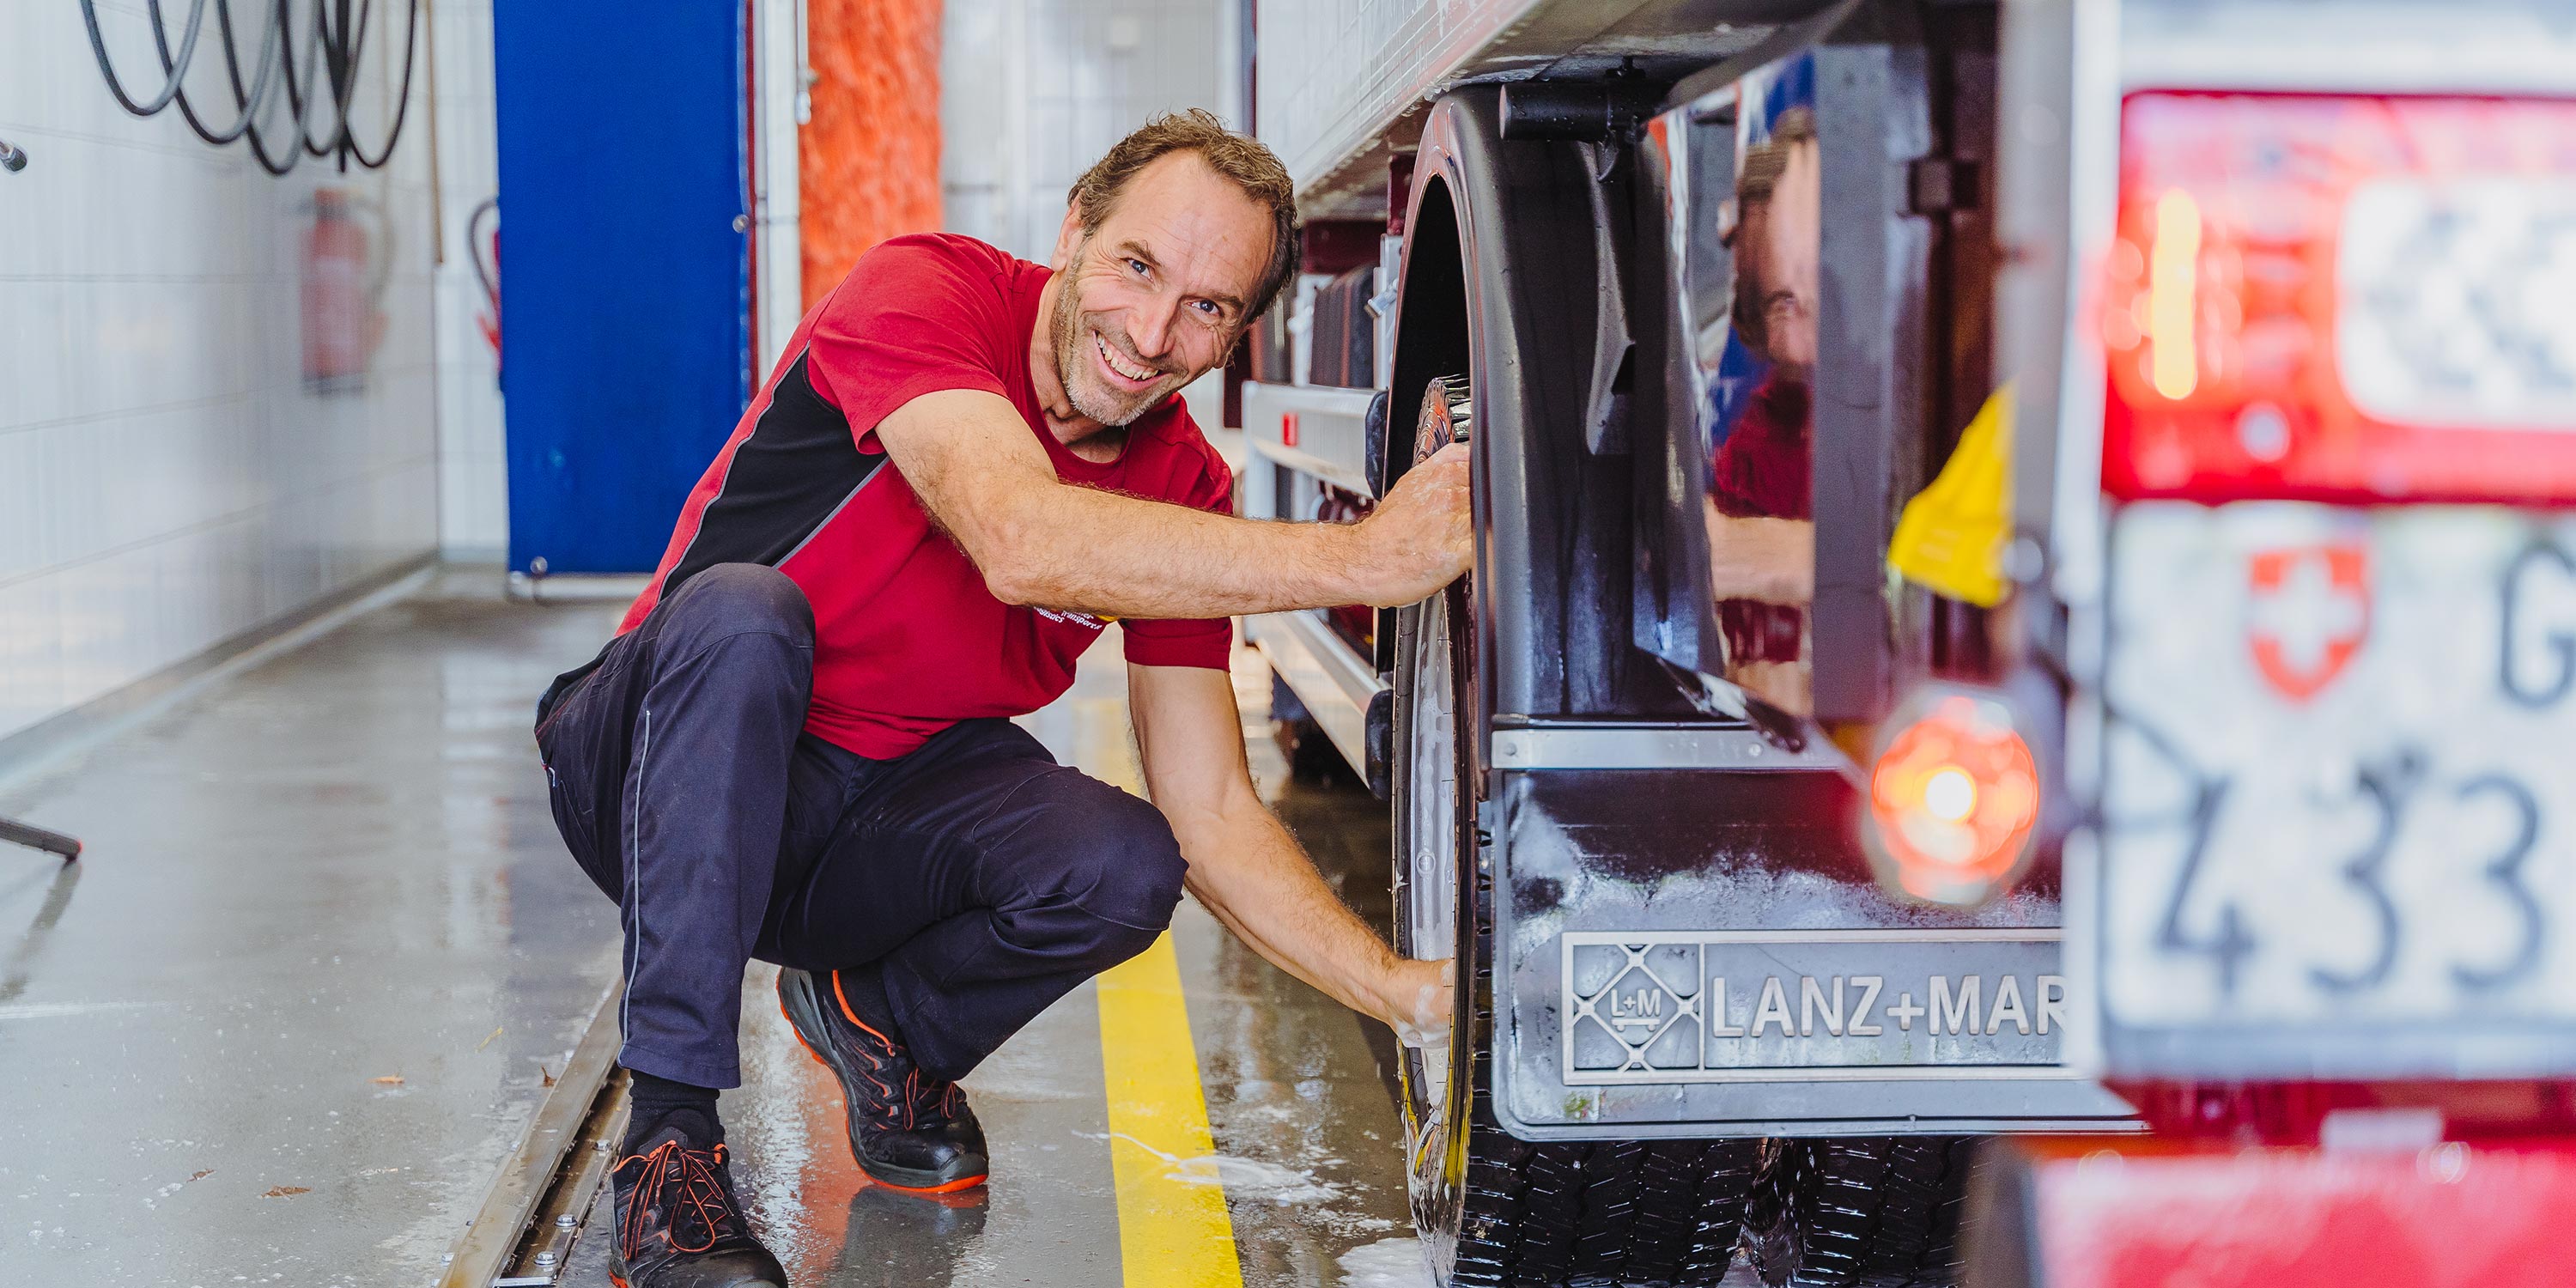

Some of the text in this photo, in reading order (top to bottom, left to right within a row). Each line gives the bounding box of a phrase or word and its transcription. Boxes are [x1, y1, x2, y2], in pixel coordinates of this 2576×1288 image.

[2500, 539, 2576, 709] G
[2155, 775, 2542, 994] 433
[1611, 988, 1662, 1017] L+M
